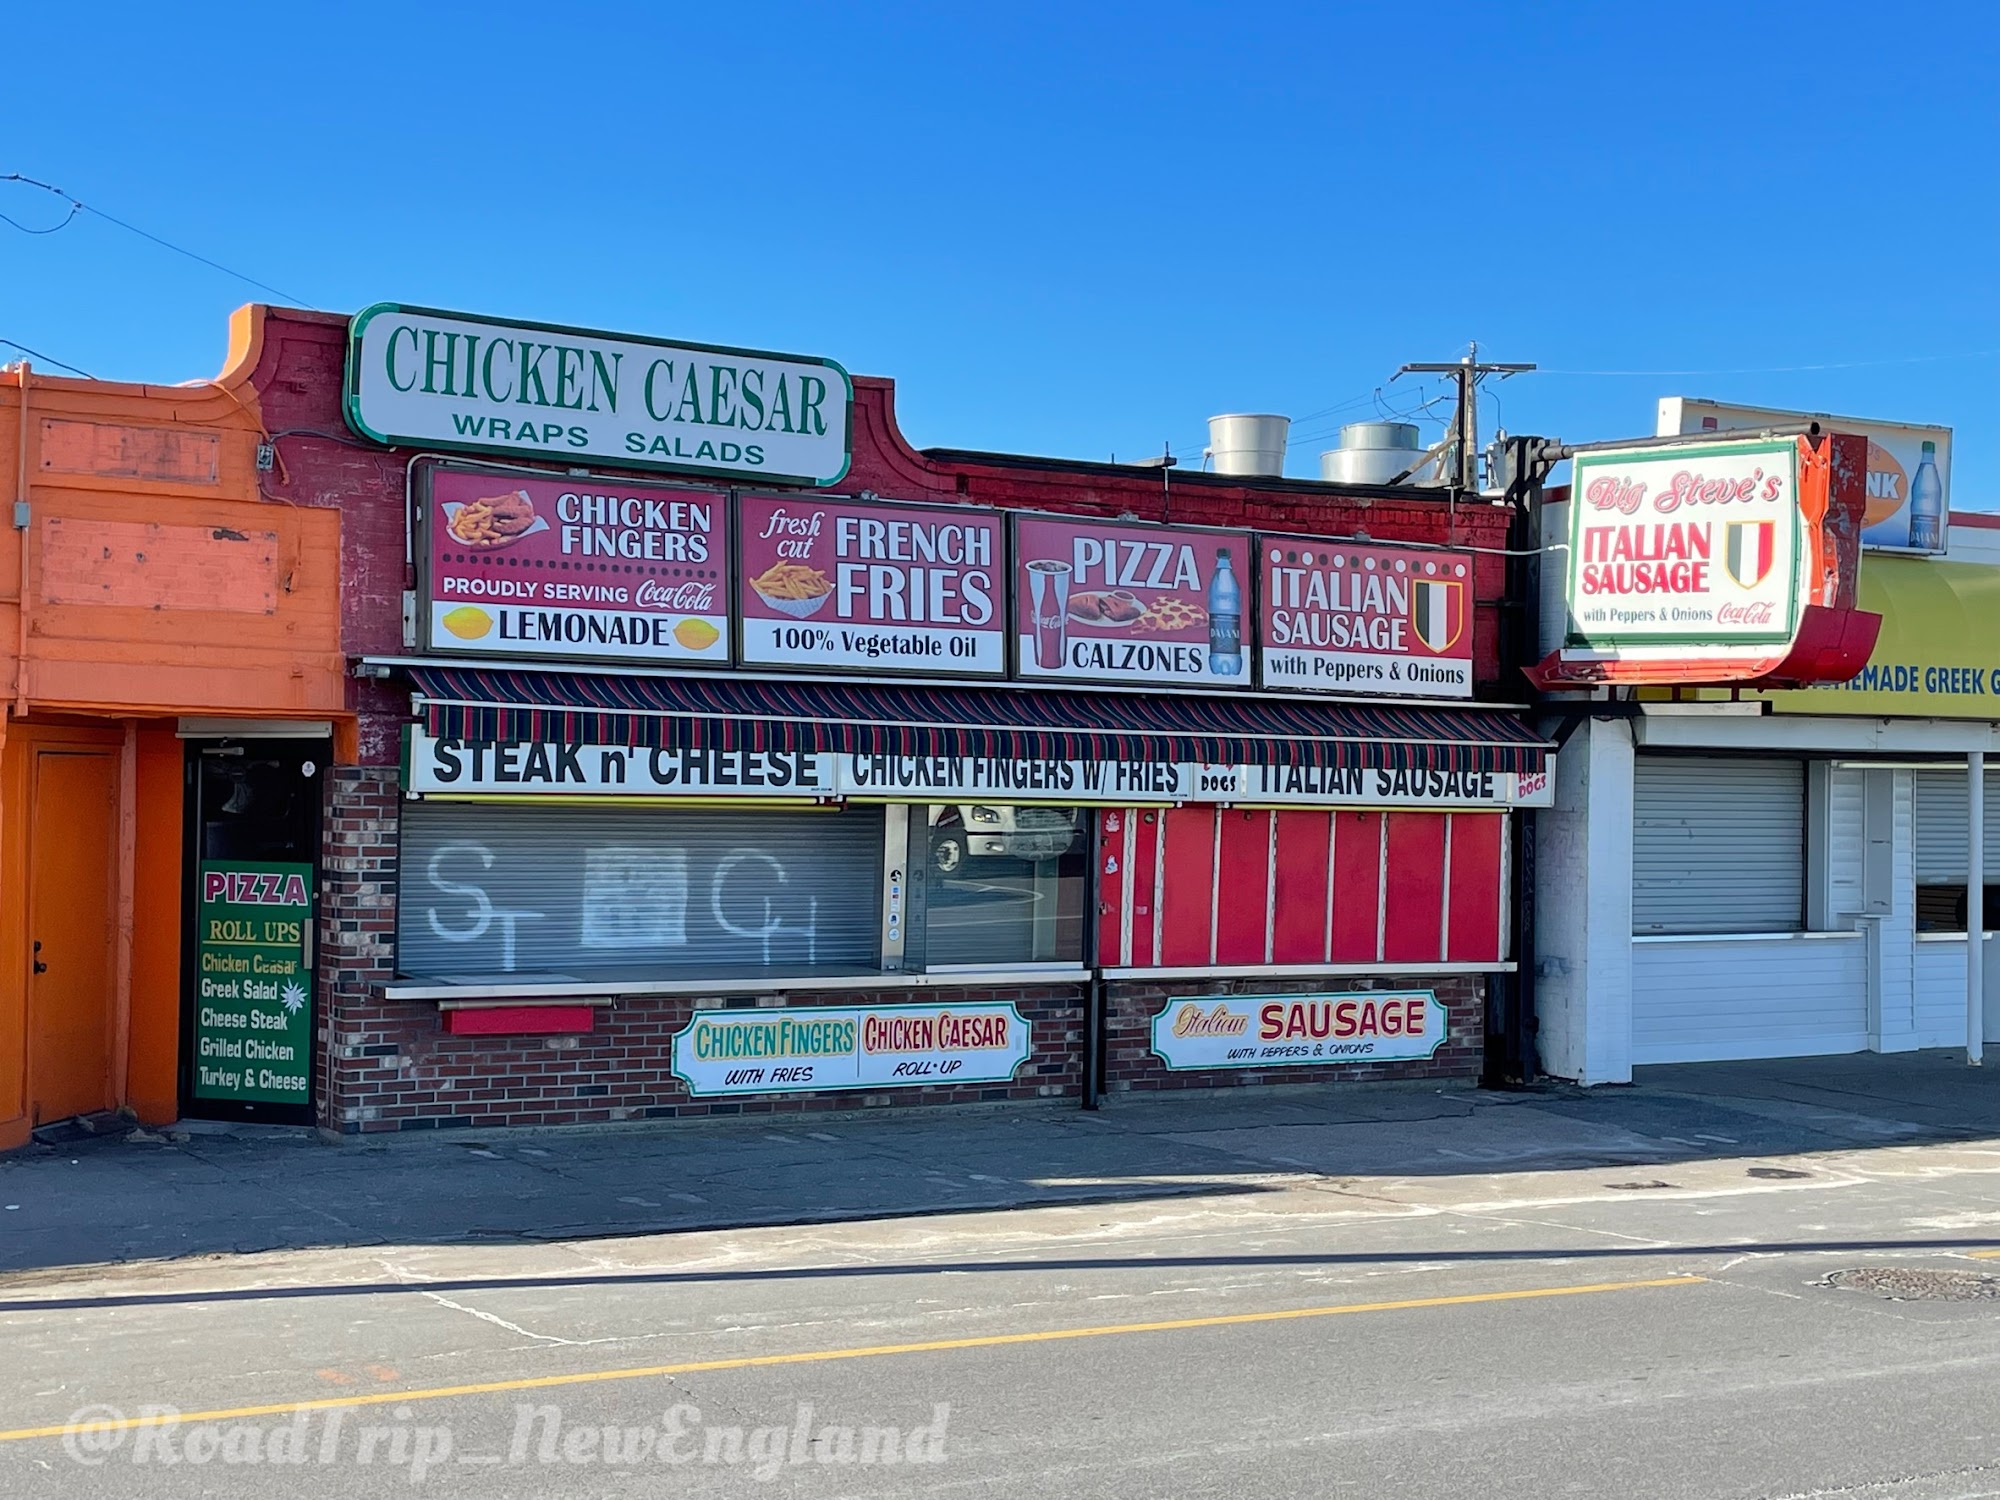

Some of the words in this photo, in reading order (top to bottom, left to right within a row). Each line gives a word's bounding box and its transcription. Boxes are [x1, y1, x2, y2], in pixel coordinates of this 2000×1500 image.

[385, 325, 623, 415] CHICKEN
[644, 358, 828, 437] CAESAR
[451, 413, 589, 448] WRAPS
[625, 432, 765, 465] SALADS
[1585, 475, 1647, 515] Big
[1653, 467, 1782, 514] Steve's
[556, 493, 711, 533] CHICKEN
[759, 508, 825, 539] fresh
[561, 525, 709, 564] FINGERS
[777, 537, 813, 558] cut
[836, 516, 991, 567] FRENCH
[1583, 521, 1712, 563] ITALIAN
[1073, 537, 1201, 591] PIZZA
[1581, 561, 1710, 595] SAUSAGE
[443, 576, 538, 599] PROUDLY
[543, 582, 628, 604] SERVING
[836, 562, 994, 626] FRIES
[1271, 567, 1408, 615] ITALIAN
[499, 610, 669, 647] LEMONADE
[1271, 610, 1409, 652] SAUSAGE
[1583, 606, 1607, 622] with
[1610, 607, 1655, 625] Peppers
[1658, 607, 1668, 621] &
[1671, 606, 1713, 621] Onions
[772, 627, 834, 651] 100%
[841, 630, 942, 658] Vegetable
[949, 636, 976, 657] Oil
[1072, 642, 1202, 673] CALZONES
[1270, 655, 1307, 675] with
[1313, 657, 1384, 682] Peppers
[1389, 662, 1401, 681] &
[1407, 662, 1464, 684] Onions
[1925, 666, 1985, 694] GREEK
[433, 738, 587, 784] STEAK
[649, 747, 819, 786] CHEESE
[852, 754, 964, 787] CHICKEN
[972, 756, 1075, 790] FINGERS
[1083, 759, 1108, 795] W/
[1115, 761, 1179, 793] FRIES
[1201, 775, 1237, 792] DOGS
[1261, 764, 1364, 796] ITALIAN
[1376, 768, 1494, 798] SAUSAGE
[1518, 775, 1546, 799] DOGS
[204, 871, 309, 906] PIZZA
[210, 920, 257, 941] ROLL
[264, 922, 300, 942] UPS
[202, 953, 249, 974] Chicken
[201, 978, 240, 999] Greek
[243, 979, 278, 1000] Salad
[201, 1007, 247, 1028] Cheese
[250, 1009, 288, 1030] Steak
[865, 1016, 933, 1050] CHICKEN
[937, 1013, 1007, 1049] CAESAR
[1260, 1001, 1425, 1039] SAUSAGE
[200, 1037, 242, 1059] Grilled
[245, 1039, 294, 1061] Chicken
[697, 1022, 778, 1059] CHICKEN
[780, 1021, 855, 1056] FINGERS
[1227, 1048, 1256, 1060] WITH
[1261, 1045, 1309, 1058] PEPPERS
[1312, 1044, 1322, 1056] &
[1330, 1043, 1374, 1054] ONIONS
[199, 1066, 241, 1091] Turkey
[244, 1068, 256, 1088] &
[259, 1069, 307, 1090] Cheese
[725, 1069, 762, 1085] WITH
[770, 1066, 813, 1082] FRIES
